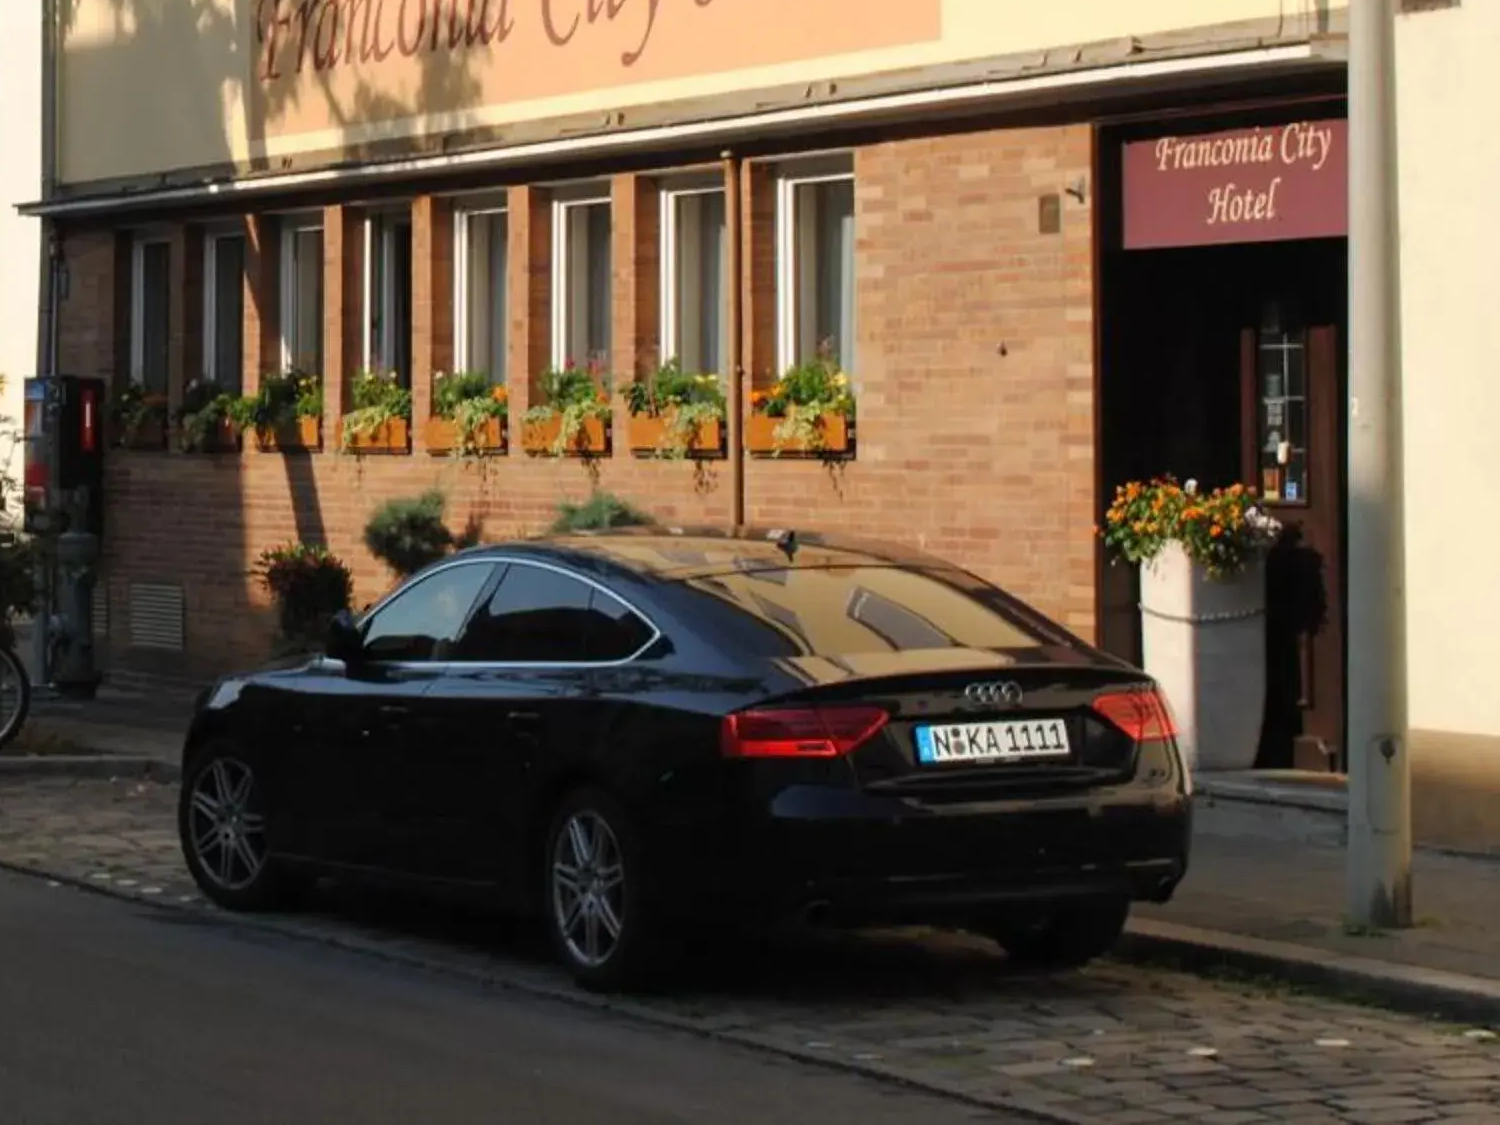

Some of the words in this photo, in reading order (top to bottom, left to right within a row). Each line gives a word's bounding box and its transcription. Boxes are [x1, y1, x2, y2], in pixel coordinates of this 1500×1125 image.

[1155, 126, 1274, 172] Franconia
[1280, 121, 1332, 171] City
[1206, 177, 1282, 225] Hotel
[1006, 722, 1066, 752] 1111
